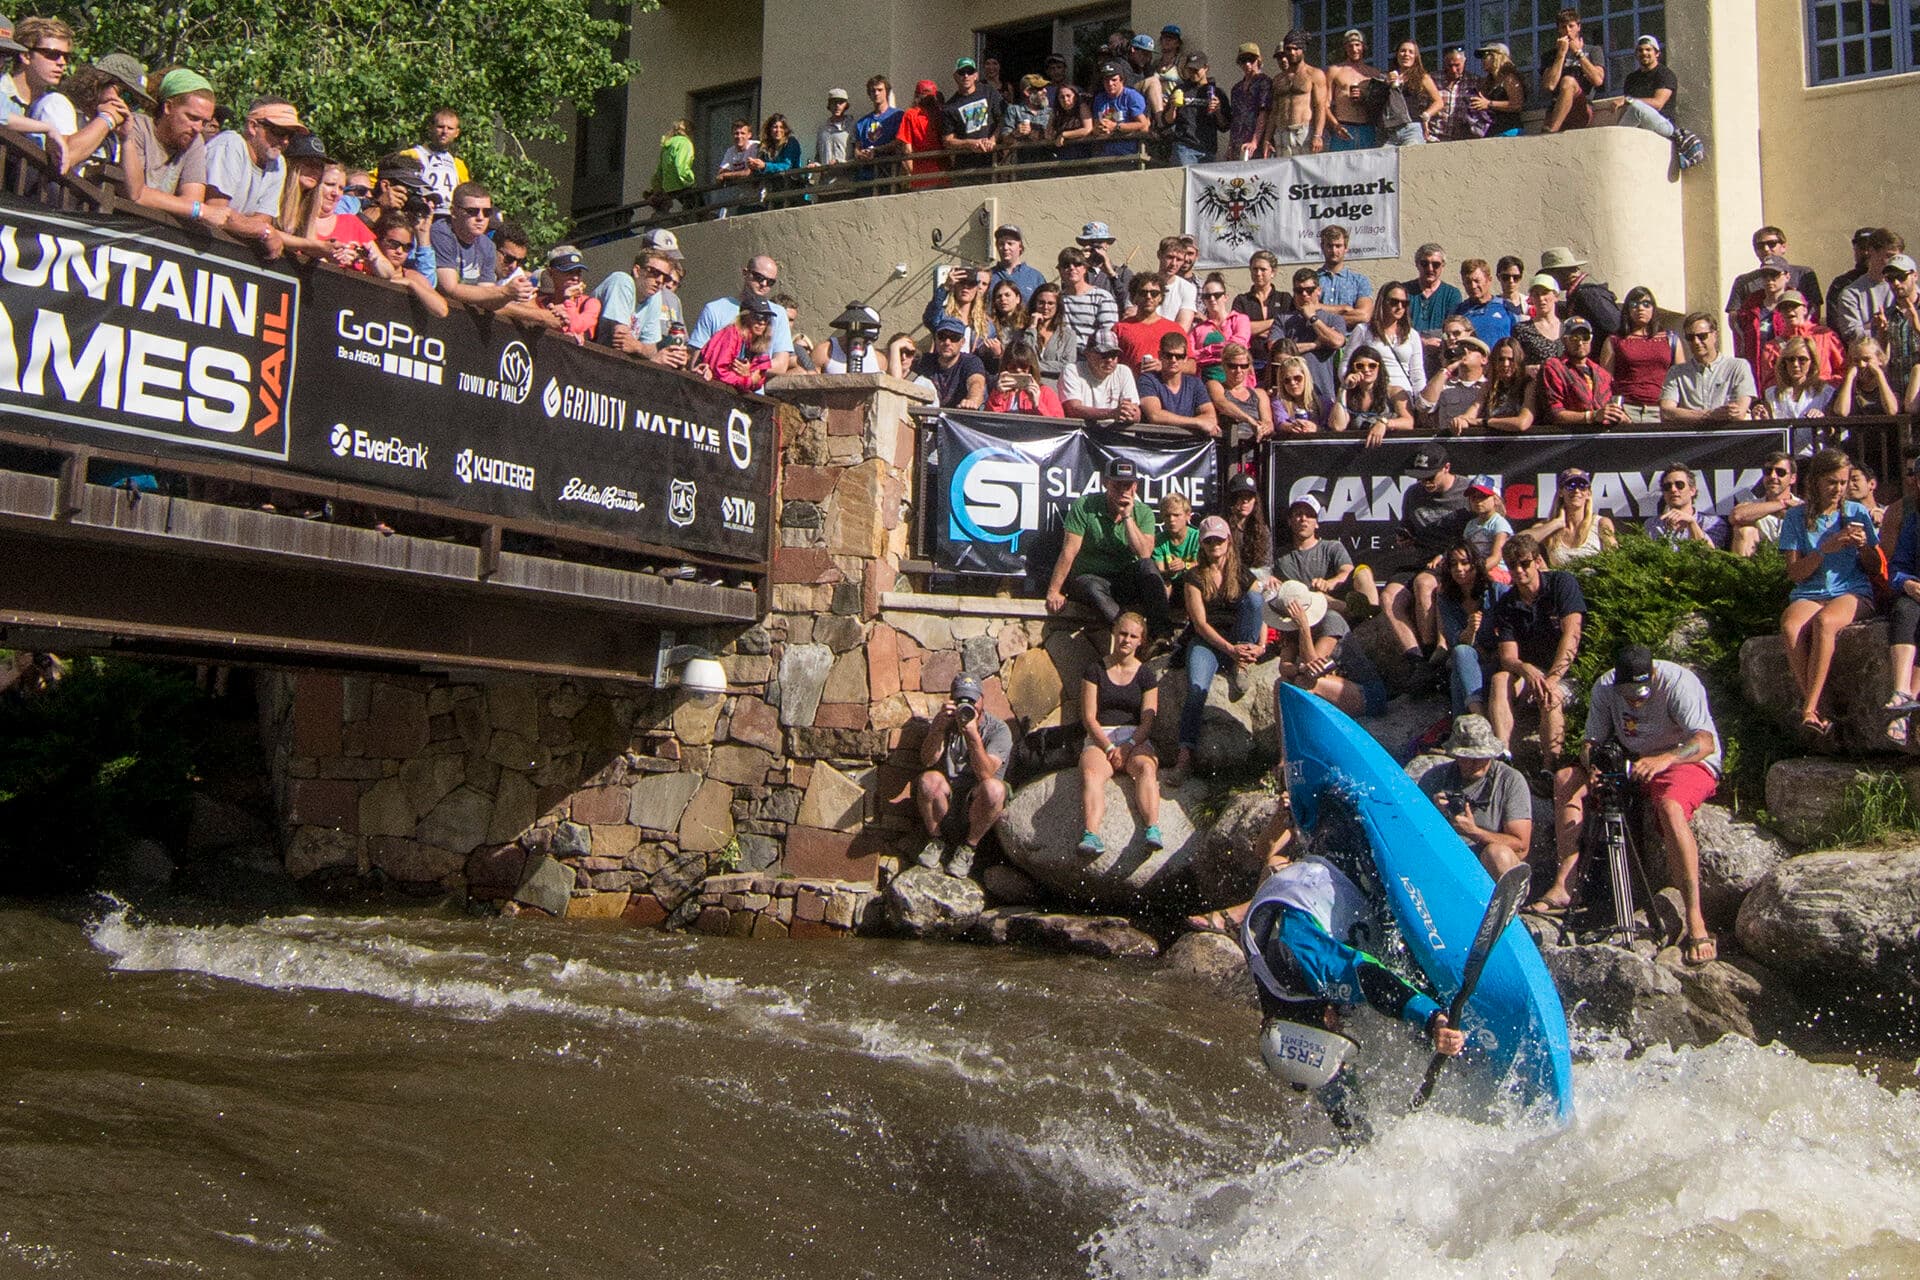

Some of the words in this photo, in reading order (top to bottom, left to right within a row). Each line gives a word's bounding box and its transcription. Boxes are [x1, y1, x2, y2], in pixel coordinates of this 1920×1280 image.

[429, 172, 454, 192] 24
[1288, 178, 1395, 201] Sitzmark
[1309, 202, 1373, 220] Lodge
[1355, 225, 1386, 236] Village
[0, 225, 258, 336] UNTAIN
[338, 309, 445, 361] GoPro
[254, 293, 288, 436] VAIL
[459, 372, 485, 395] TOWN
[487, 379, 499, 399] OF
[501, 382, 518, 403] VAIL
[636, 409, 720, 447] NATIVE
[354, 429, 428, 470] EverBank
[474, 456, 535, 491] KYOCERA
[1046, 467, 1205, 507] SLALINE
[558, 477, 600, 504] Eddie
[600, 486, 645, 512] Bauer
[731, 497, 755, 526] TV8
[1399, 876, 1446, 950] Dagger
[1277, 1044, 1324, 1068] FIRST
